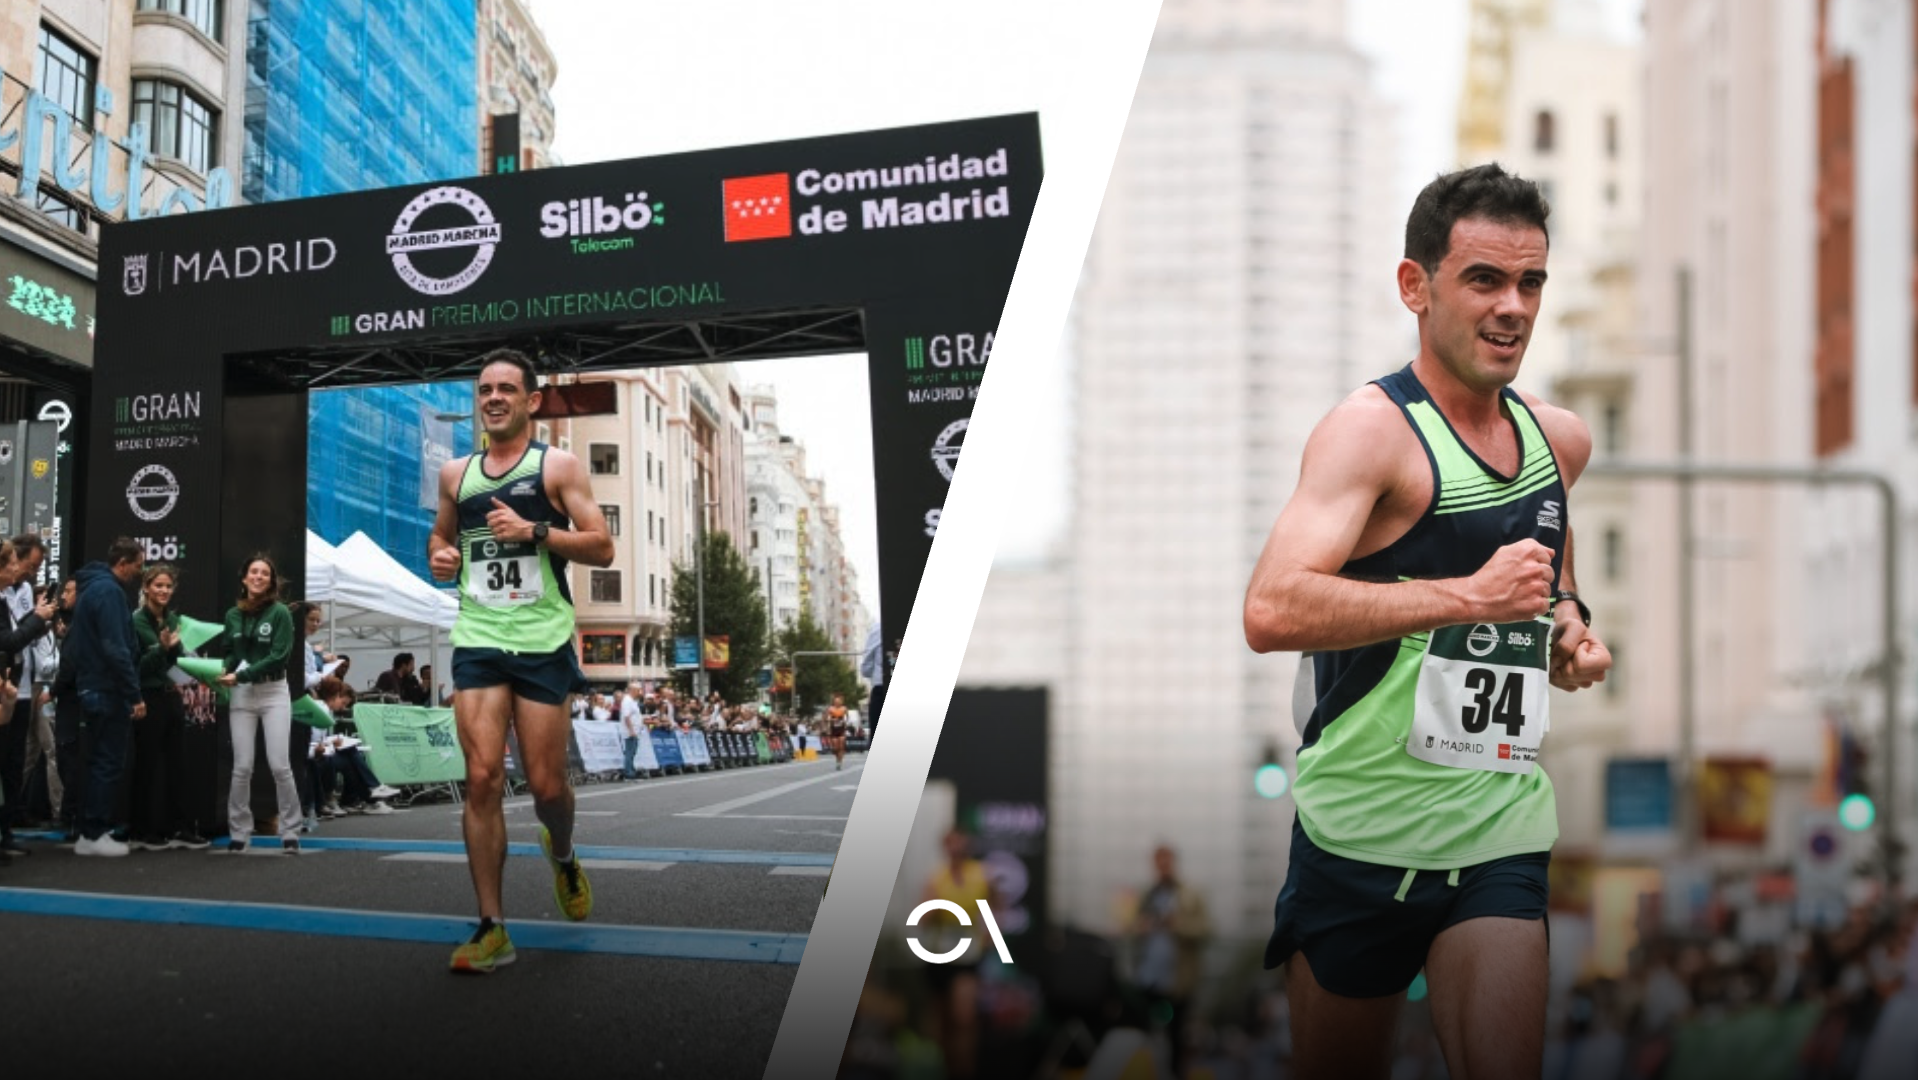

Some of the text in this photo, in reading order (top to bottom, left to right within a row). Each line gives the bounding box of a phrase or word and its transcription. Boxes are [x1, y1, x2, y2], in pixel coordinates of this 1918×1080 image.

[796, 148, 1008, 196] Comunidad
[798, 186, 1009, 235] de Madrid
[389, 226, 498, 249] MADRID MARCHA
[570, 237, 634, 254] Telecom
[173, 237, 337, 285] MADRID
[355, 308, 425, 333] GRAN
[432, 299, 519, 327] PREMIO
[526, 281, 725, 319] INTERNACIONAL
[132, 391, 200, 421] GRAN
[487, 560, 522, 591] 34
[1461, 667, 1526, 737] 34
[1440, 739, 1540, 754] MADRID Comuni
